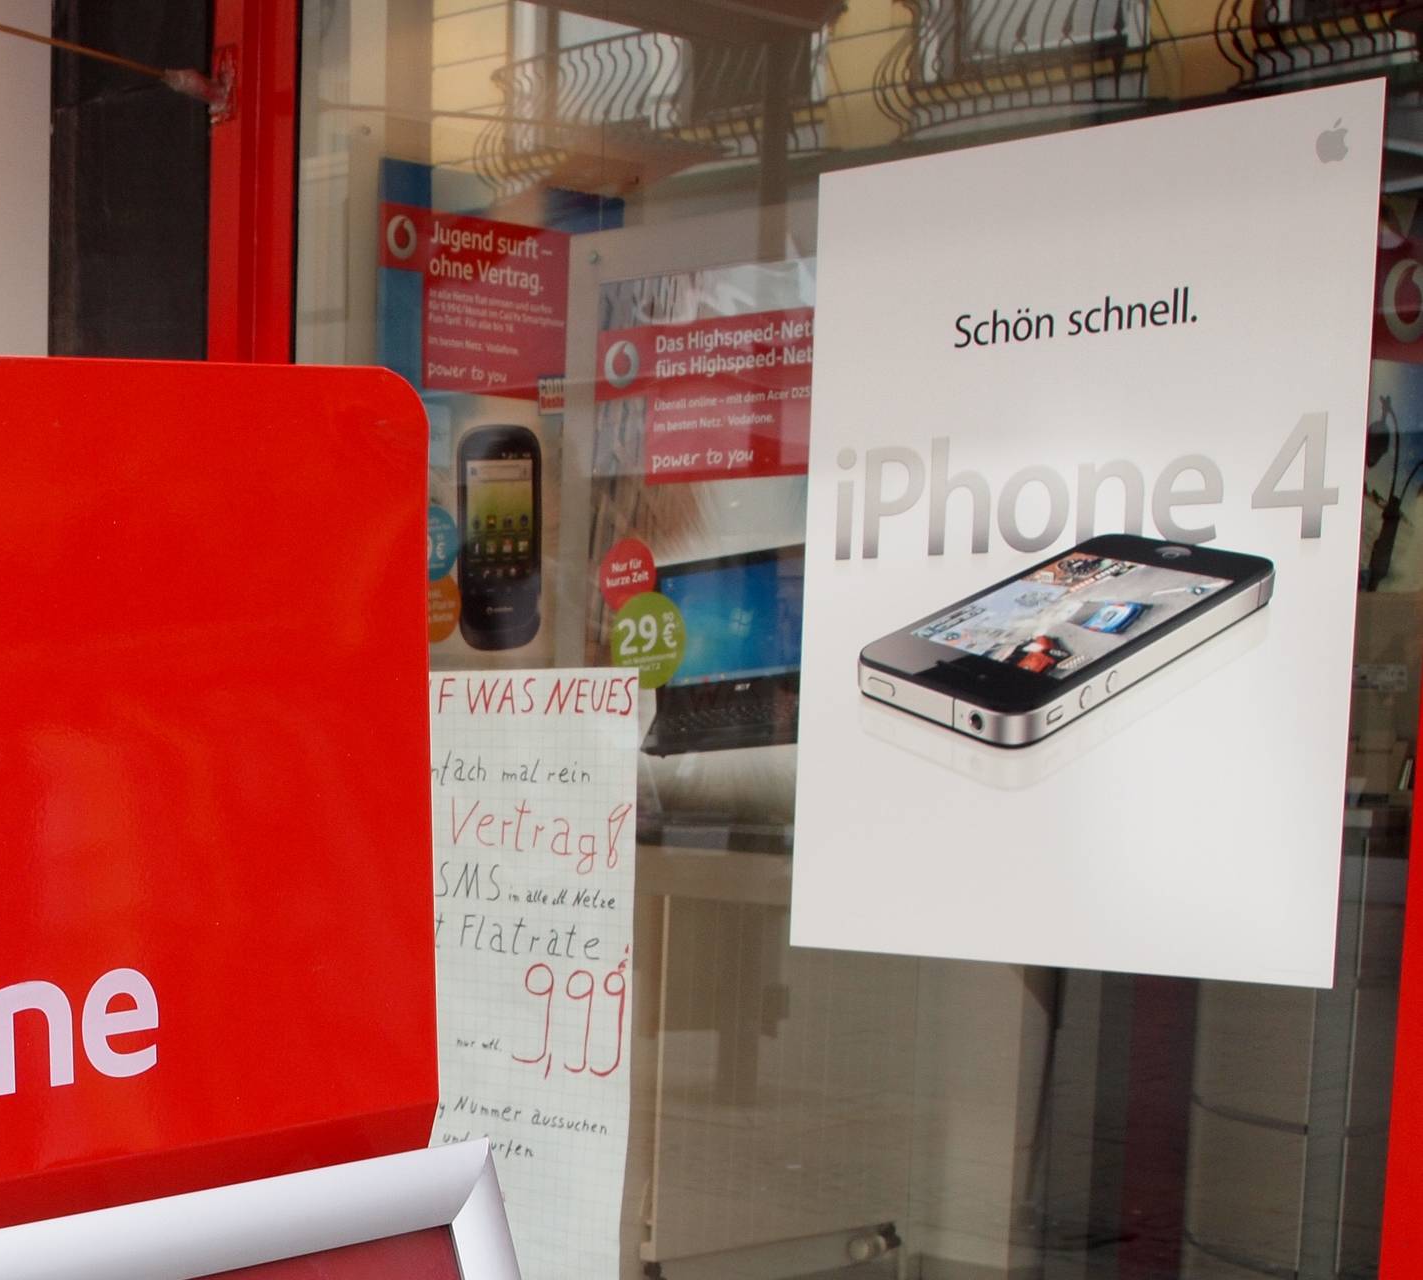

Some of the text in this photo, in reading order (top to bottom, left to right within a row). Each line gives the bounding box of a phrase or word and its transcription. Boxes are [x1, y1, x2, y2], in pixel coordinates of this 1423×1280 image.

[430, 221, 493, 253] Jugend
[497, 234, 539, 260] surft
[430, 254, 544, 297] ohne Vertrag.
[954, 286, 1199, 349] Schön schnell.
[656, 319, 814, 354] Das Highspeed-Net
[428, 362, 508, 386] power to you
[656, 358, 686, 379] fürs
[767, 388, 790, 401] Acer
[652, 448, 754, 474] power to you
[833, 411, 1340, 561] iPhone 4
[606, 572, 649, 588] kurze Zeit
[612, 559, 642, 573] Nur für
[618, 614, 657, 656] 29
[466, 678, 536, 715] WAS
[544, 676, 638, 716] NEUES
[502, 758, 541, 784] mal
[547, 761, 591, 784] rein
[435, 860, 501, 901] SMS
[526, 888, 547, 904] alle
[572, 887, 616, 909] Netze
[459, 913, 601, 961] Flatrate
[454, 1095, 522, 1121] Nummer
[531, 1108, 608, 1135] aussuchen
[483, 1133, 534, 1158] urfen
